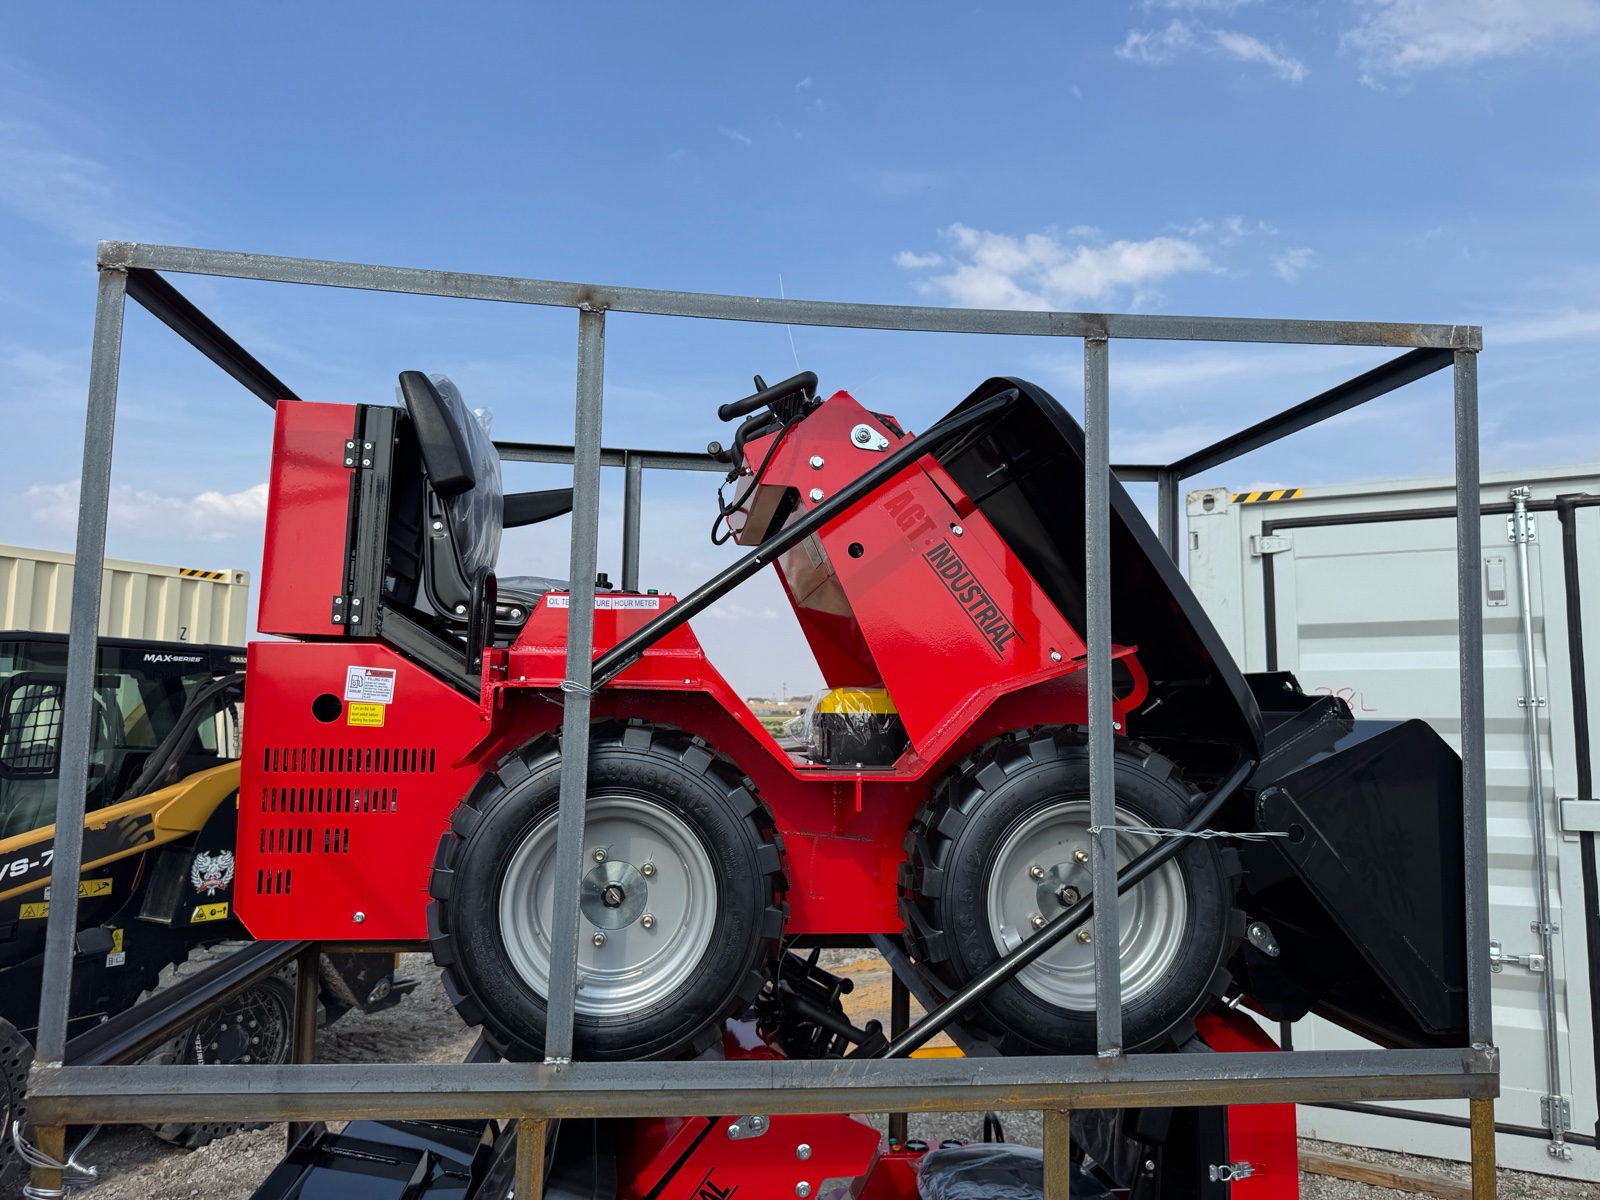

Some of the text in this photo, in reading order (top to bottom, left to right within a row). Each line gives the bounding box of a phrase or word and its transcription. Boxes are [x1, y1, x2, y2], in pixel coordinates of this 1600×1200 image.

[614, 599, 657, 607] HOUR METER
[926, 542, 1015, 652] INDUSTRIAL
[180, 627, 187, 640] Z
[143, 653, 202, 663] MAX-SERIES
[976, 824, 994, 848] NHS
